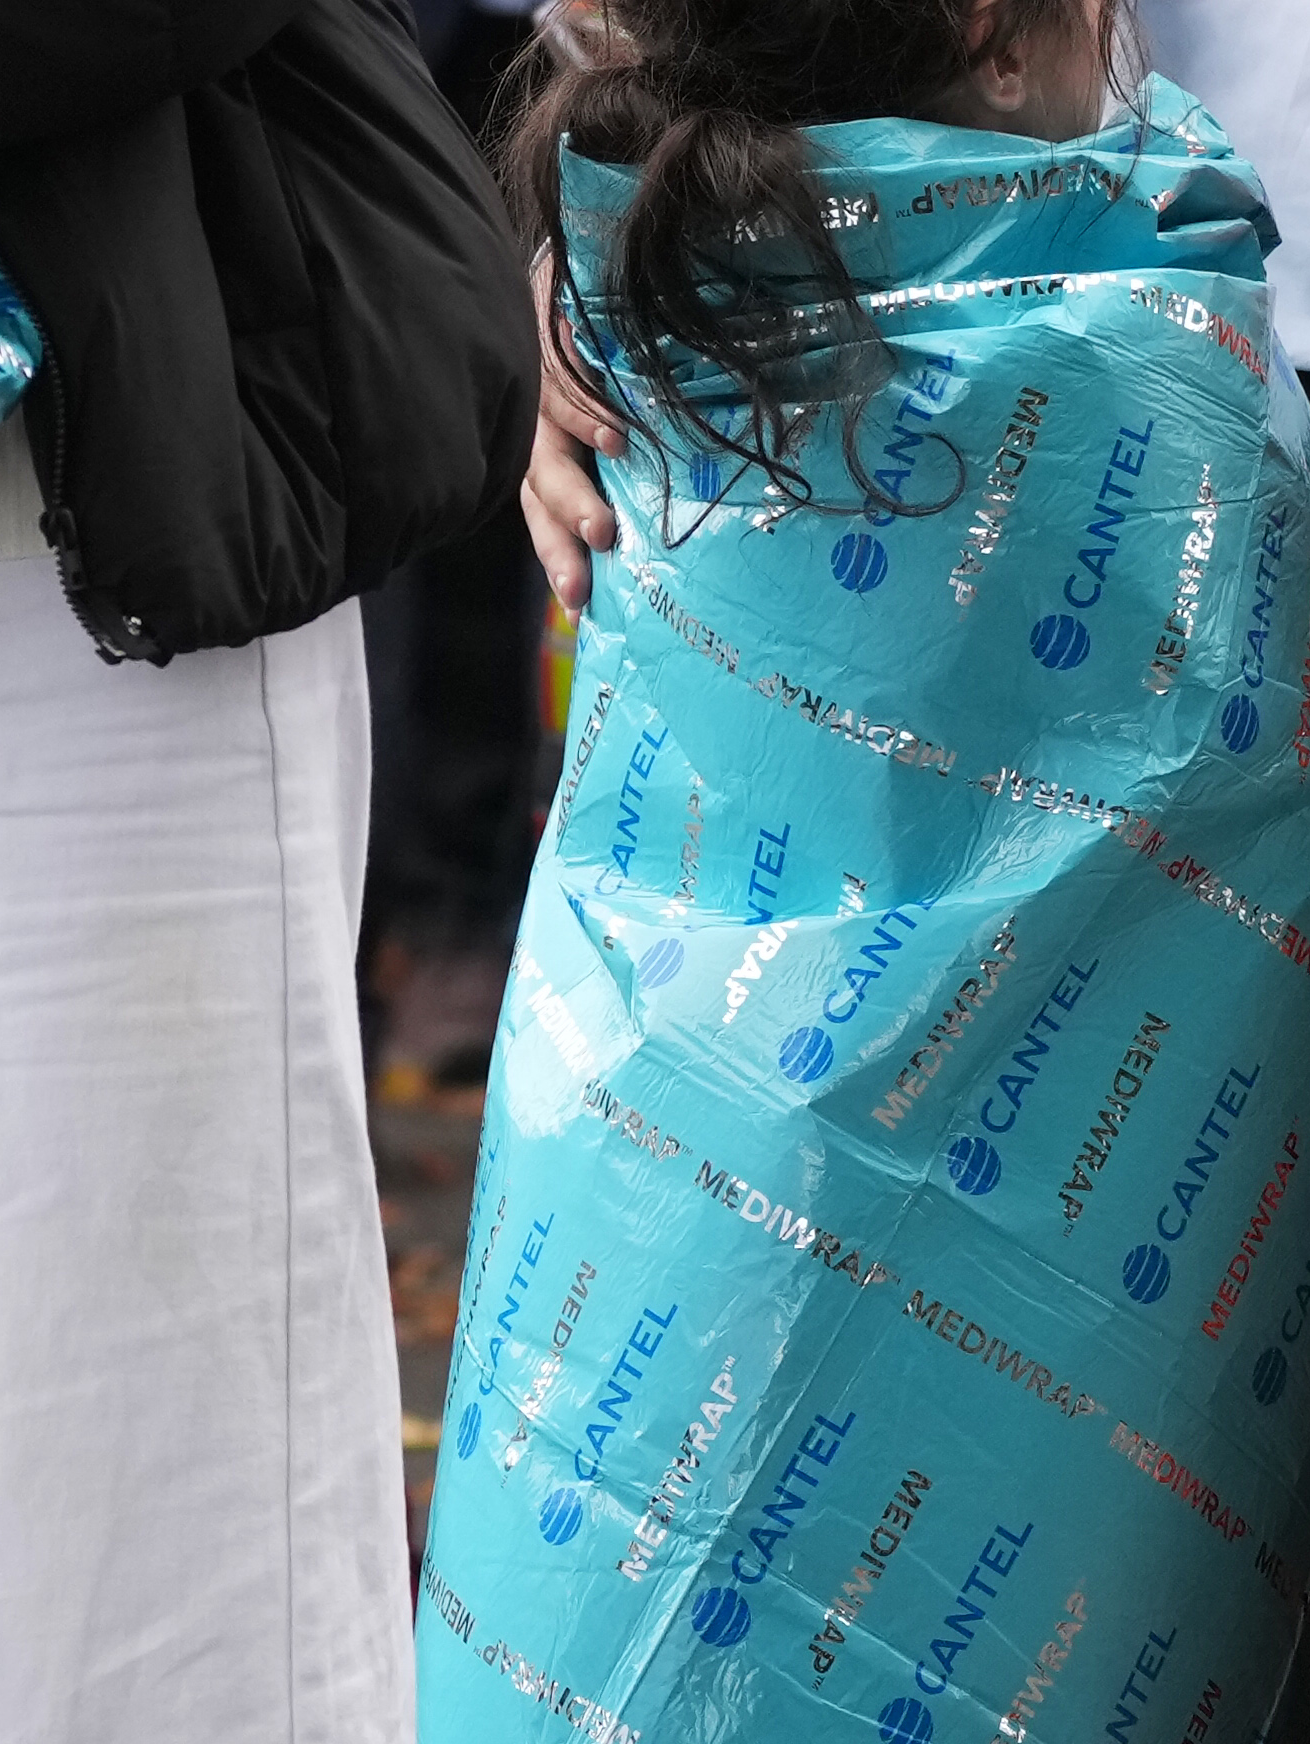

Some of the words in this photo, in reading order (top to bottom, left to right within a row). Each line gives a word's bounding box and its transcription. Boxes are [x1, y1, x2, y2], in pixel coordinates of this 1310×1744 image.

[1129, 278, 1269, 386] MEDIWRA
[1063, 417, 1156, 609] CANTEL
[1242, 507, 1289, 689] CANTEL
[593, 725, 669, 896] CANTEL
[744, 821, 791, 925] NTEL
[820, 894, 937, 1024] CANT
[979, 957, 1100, 1135] CANTEL
[1157, 1062, 1262, 1242] CANTEL
[1201, 1129, 1300, 1342] MEDIWRAP
[478, 1212, 554, 1397] CANTEL
[574, 1301, 679, 1484] CANTEL
[731, 1411, 857, 1586] CANTEL
[915, 1522, 1035, 1695] CANTEL
